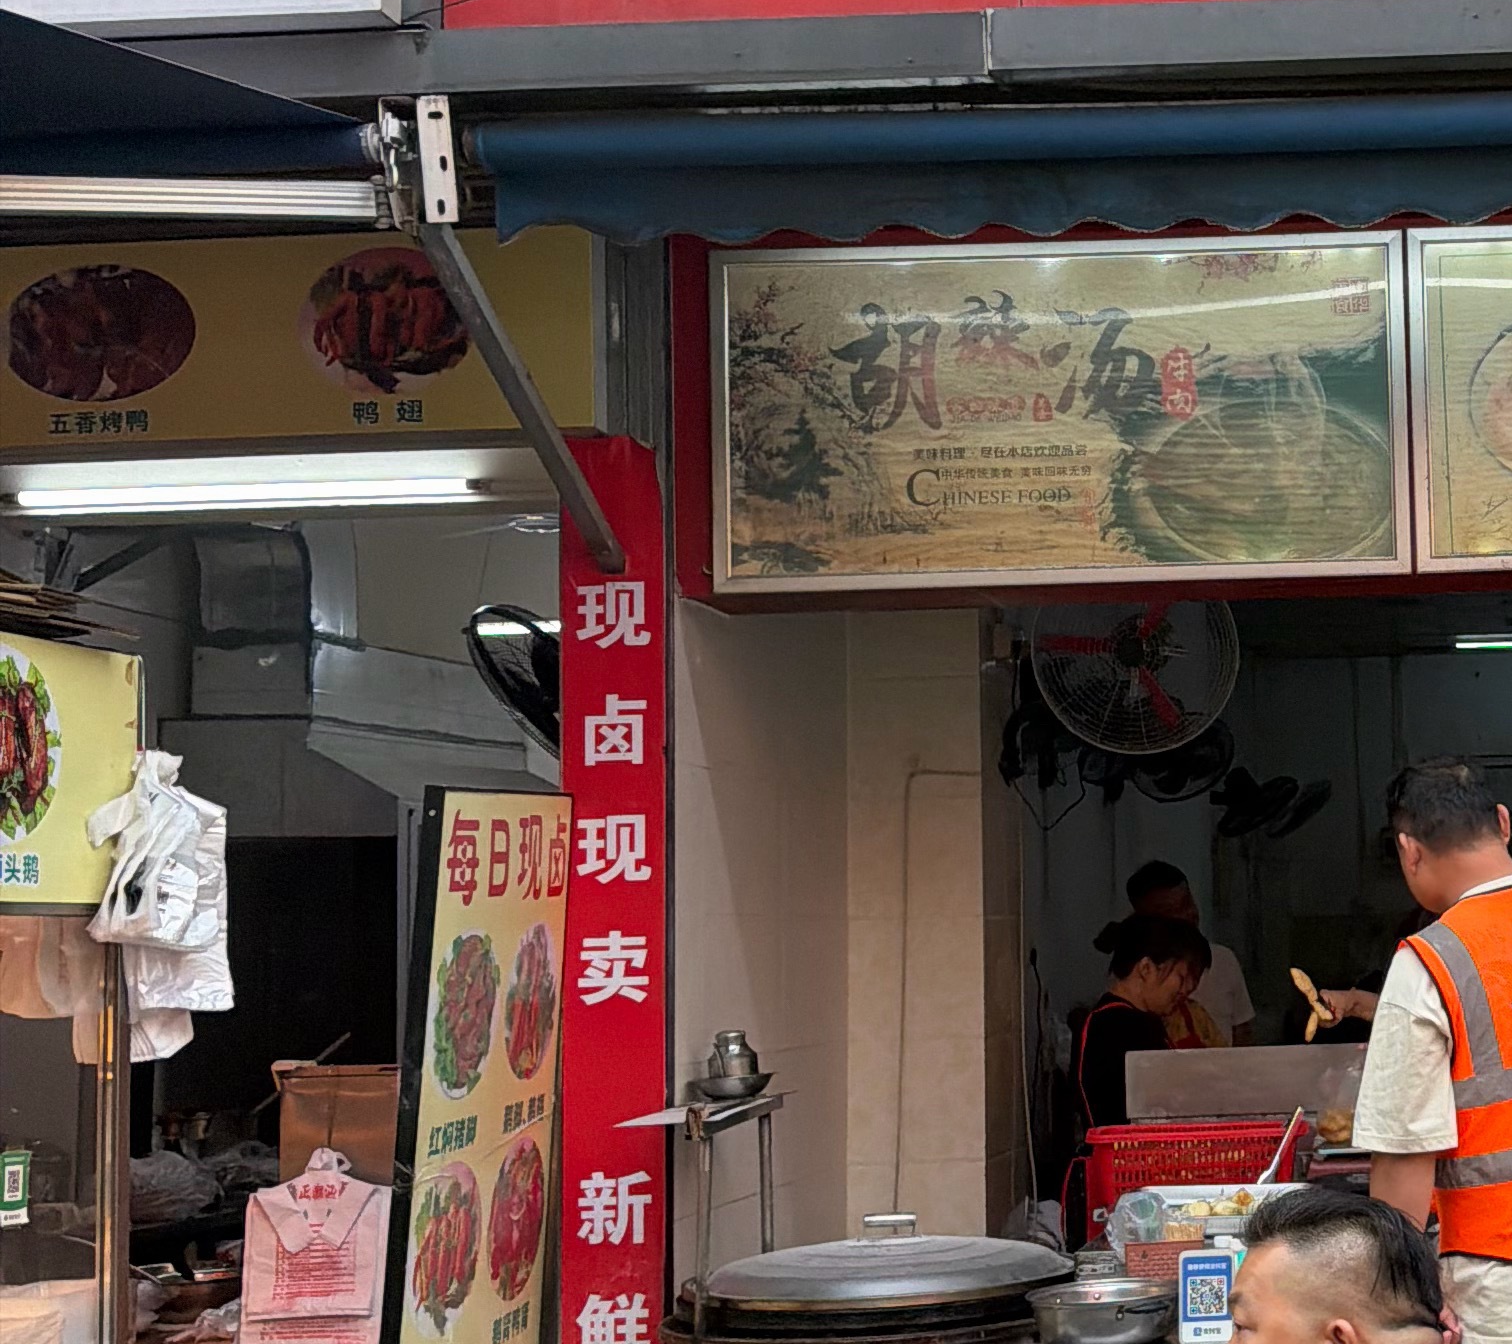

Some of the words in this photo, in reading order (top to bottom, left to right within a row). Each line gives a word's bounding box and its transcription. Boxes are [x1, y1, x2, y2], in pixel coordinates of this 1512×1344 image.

[49, 409, 149, 435] 五香烤鸭
[352, 399, 424, 426] 鸭翅
[1018, 485, 1072, 504] FOOD
[576, 580, 653, 1006] 现卤现卖
[0, 852, 39, 885] 头鹅
[446, 809, 569, 907] 每日现卤
